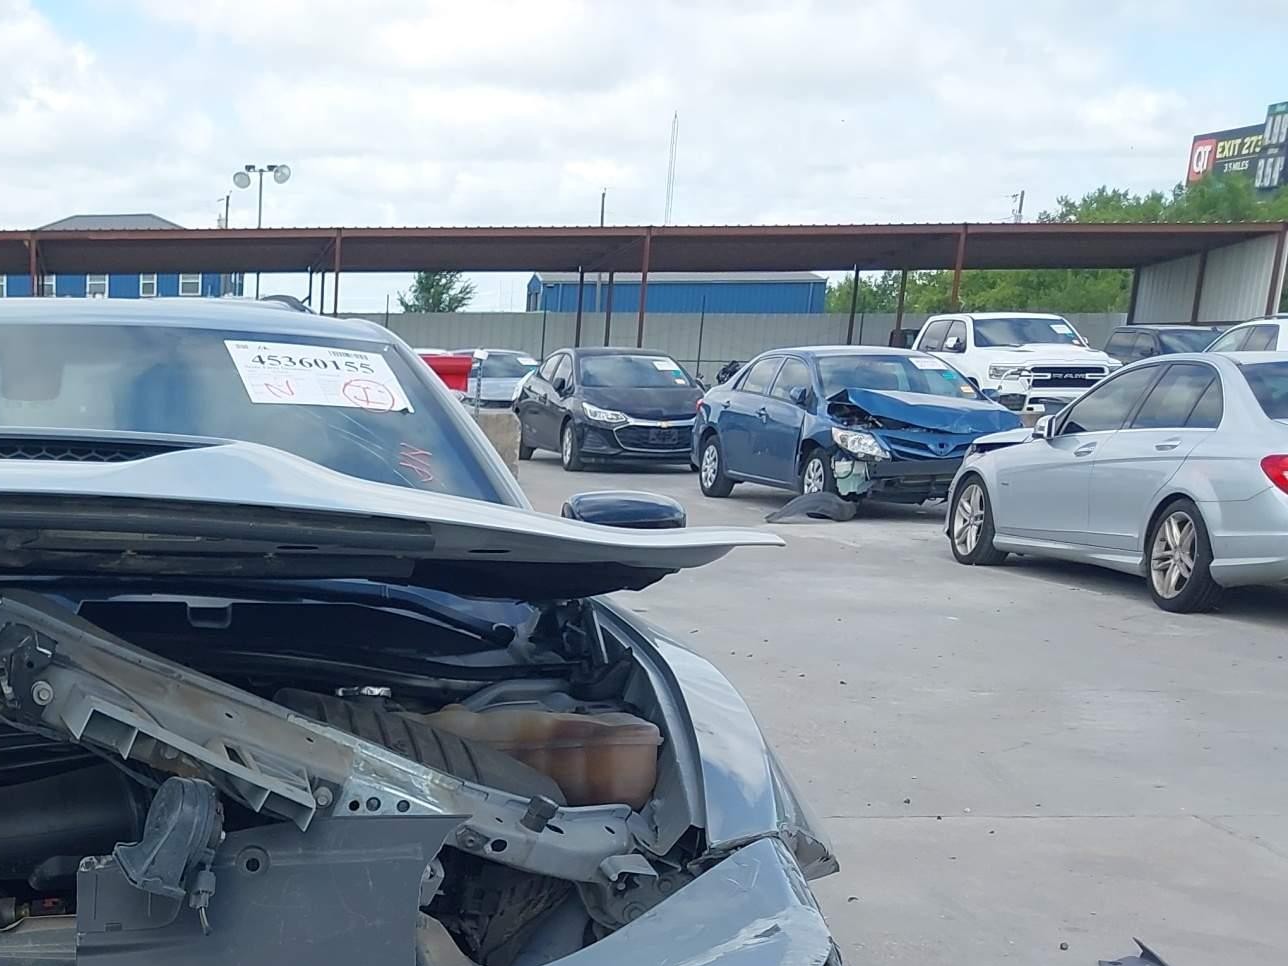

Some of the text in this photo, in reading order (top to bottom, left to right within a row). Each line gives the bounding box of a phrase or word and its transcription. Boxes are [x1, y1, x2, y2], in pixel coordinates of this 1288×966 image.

[1216, 139, 1242, 158] EXIT
[1193, 145, 1212, 175] QT
[251, 354, 375, 374] 45360155
